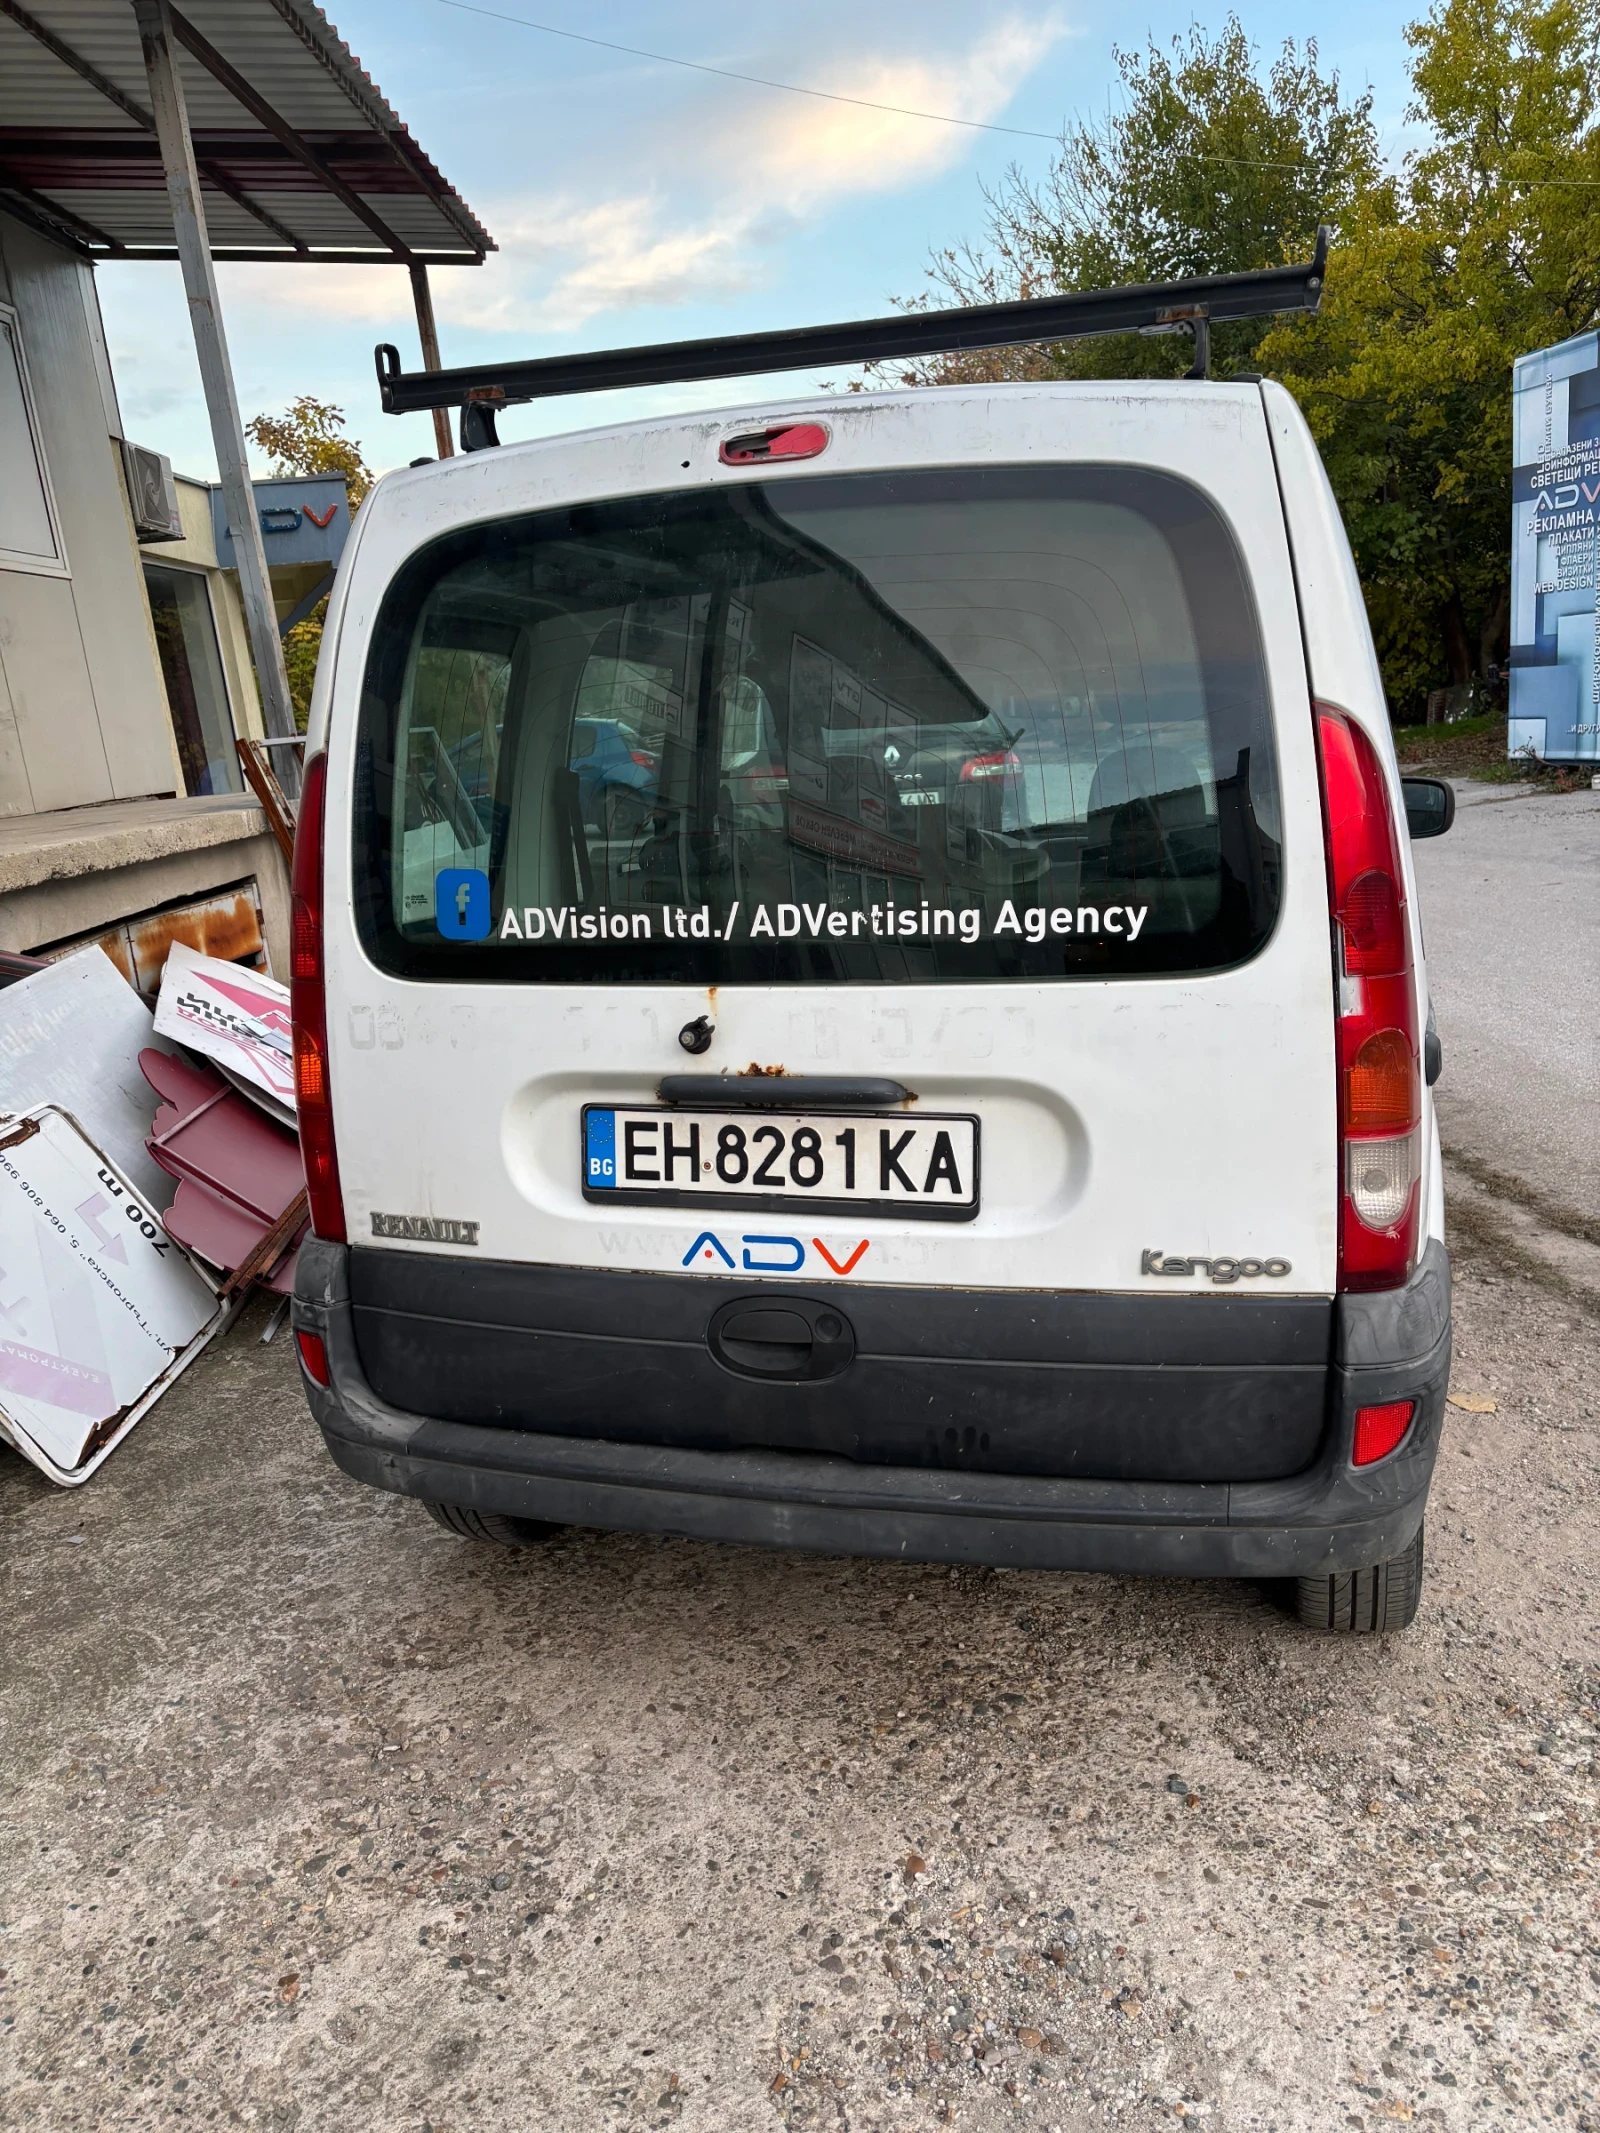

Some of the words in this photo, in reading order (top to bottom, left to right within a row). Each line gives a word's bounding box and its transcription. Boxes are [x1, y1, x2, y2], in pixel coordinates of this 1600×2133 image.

[1530, 465, 1582, 489] СВЕТЕЩИ
[224, 503, 339, 539] DV
[1526, 508, 1595, 535] РЕКЛАМНА
[1548, 526, 1595, 546] ПЛАКАТИ
[1555, 541, 1594, 557] ДИПЛЯНИ
[1557, 564, 1594, 578] ВИЗИТКИ
[1560, 553, 1594, 566] ФЛАЕРИ
[1533, 581, 1554, 594] WEB
[1556, 575, 1594, 592] DESIGN
[500, 906, 652, 940] ADVision
[749, 900, 981, 944] ADVertising
[993, 899, 1148, 943] Agency
[590, 1157, 614, 1176] BG
[624, 1120, 701, 1183] EH
[716, 1123, 856, 1190] 8281
[879, 1128, 963, 1195] KA
[19, 1180, 44, 1208] 806
[43, 1206, 67, 1235] 064
[125, 1203, 171, 1259] 700
[369, 1210, 481, 1246] RENAULT
[681, 1231, 870, 1276] ADV
[1141, 1248, 1293, 1285] Kangoo
